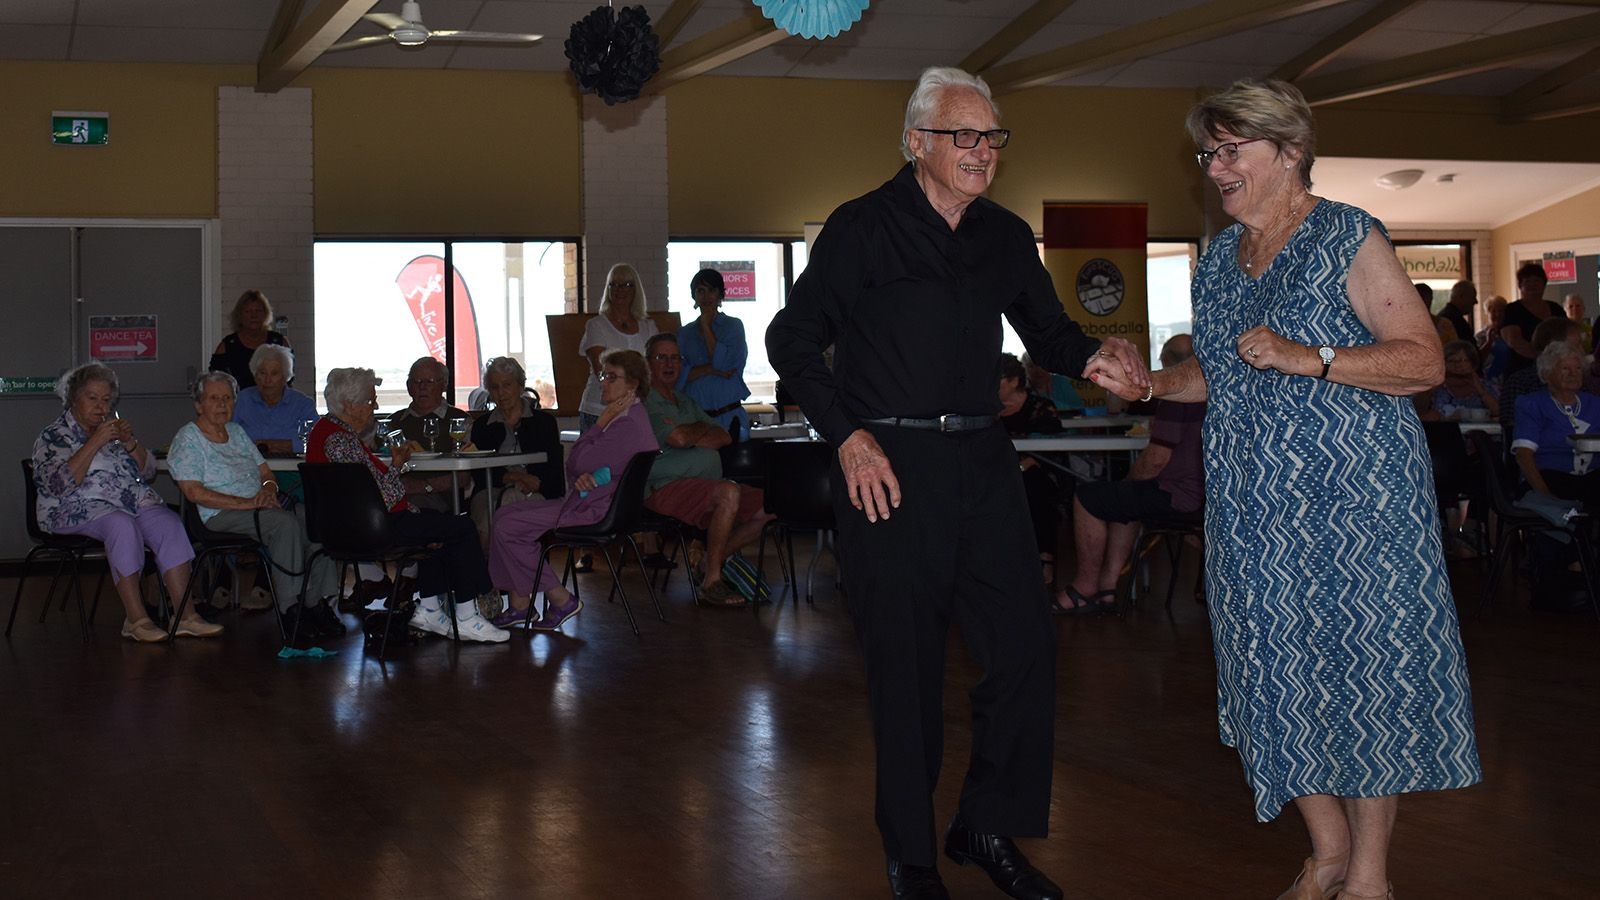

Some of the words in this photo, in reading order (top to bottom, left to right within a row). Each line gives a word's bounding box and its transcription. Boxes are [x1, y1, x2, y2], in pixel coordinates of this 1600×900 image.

[724, 287, 750, 295] VICES
[1080, 321, 1143, 334] obodalla
[94, 331, 129, 341] DANCE
[133, 331, 153, 341] TEA
